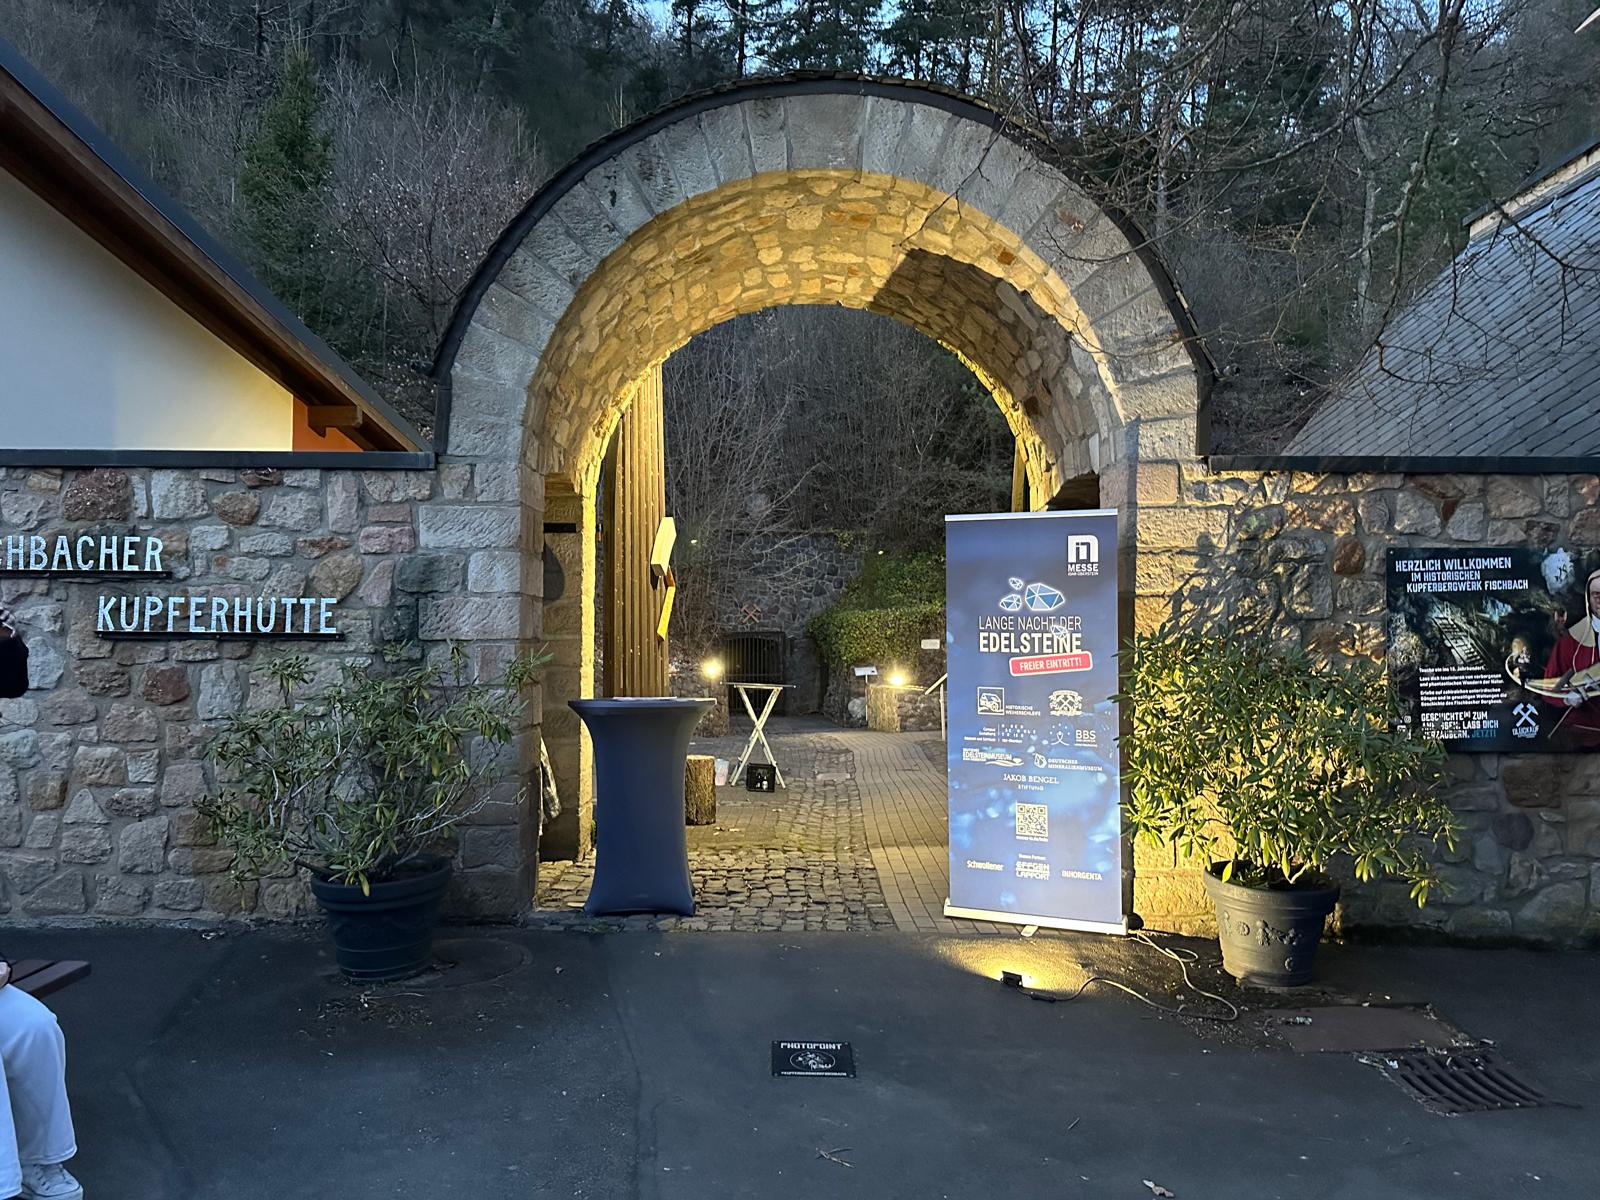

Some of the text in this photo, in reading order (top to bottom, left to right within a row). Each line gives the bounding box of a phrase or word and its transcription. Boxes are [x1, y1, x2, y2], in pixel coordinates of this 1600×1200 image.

[0, 535, 163, 570] HBACHER
[1067, 563, 1099, 572] MESSE
[1395, 557, 1512, 572] HERZLICH WILLKOMMEN
[1411, 571, 1480, 582] IM HISTORISCHEN
[1406, 580, 1529, 593] KUPFERBERGWERK FISCHBACH
[97, 596, 338, 633] KUPFERHÜTTE
[979, 616, 1082, 630] LANGE NACHT DER
[979, 632, 1082, 653] EDELSTEINE
[1019, 657, 1083, 671] FREIER EINTRITT!
[1472, 711, 1488, 720] ZUM
[1462, 721, 1480, 730] LASS
[1482, 720, 1499, 729] DICH
[1075, 729, 1096, 740] BBS
[1003, 773, 1059, 784] JAKOB BENGEL
[966, 860, 1004, 871] Schwollener
[780, 1042, 842, 1050] PHOTOPOINT
